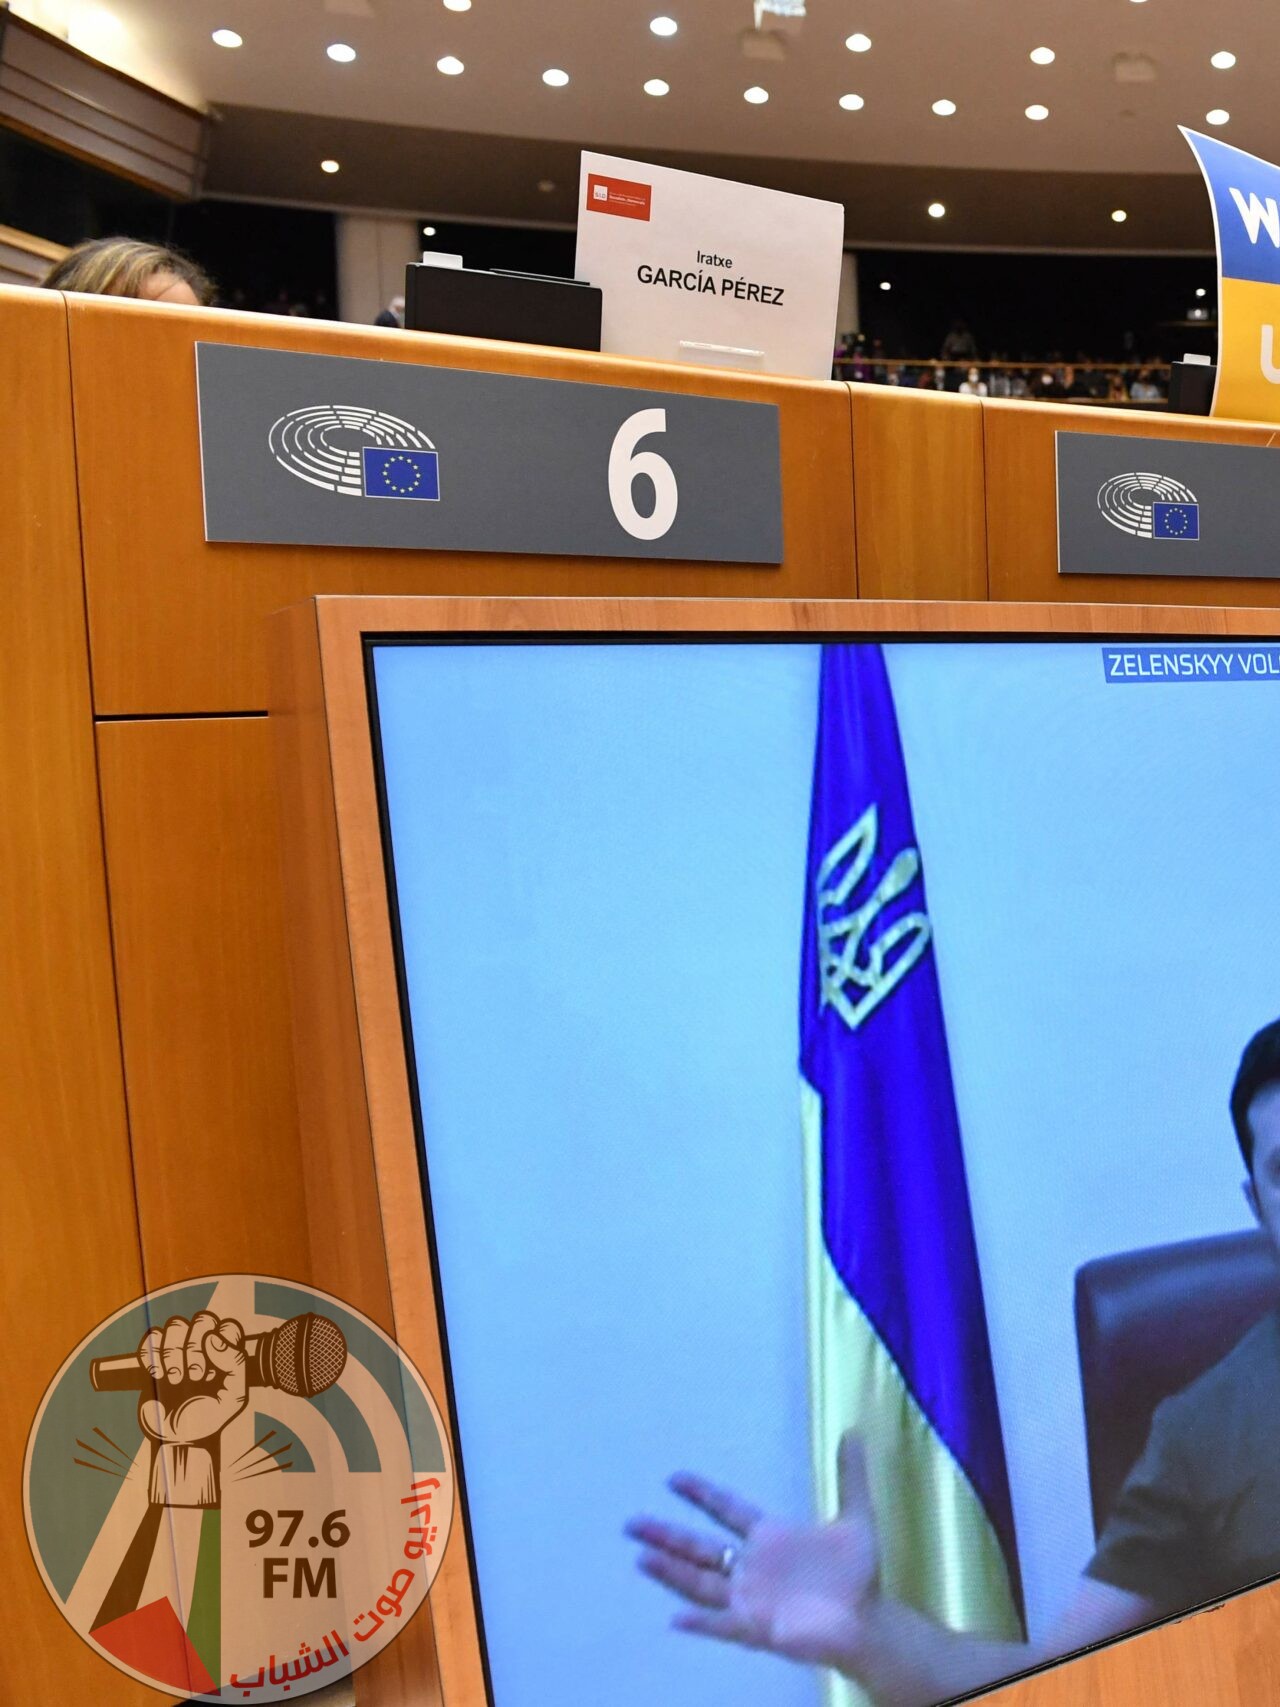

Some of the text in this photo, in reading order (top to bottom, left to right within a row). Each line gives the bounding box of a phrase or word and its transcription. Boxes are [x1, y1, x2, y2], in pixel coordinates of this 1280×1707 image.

[697, 250, 733, 268] Iratxe
[637, 264, 785, 306] GARCÍA PÉREZ
[608, 408, 678, 540] 6
[1108, 653, 1234, 677] ZELENSKYY
